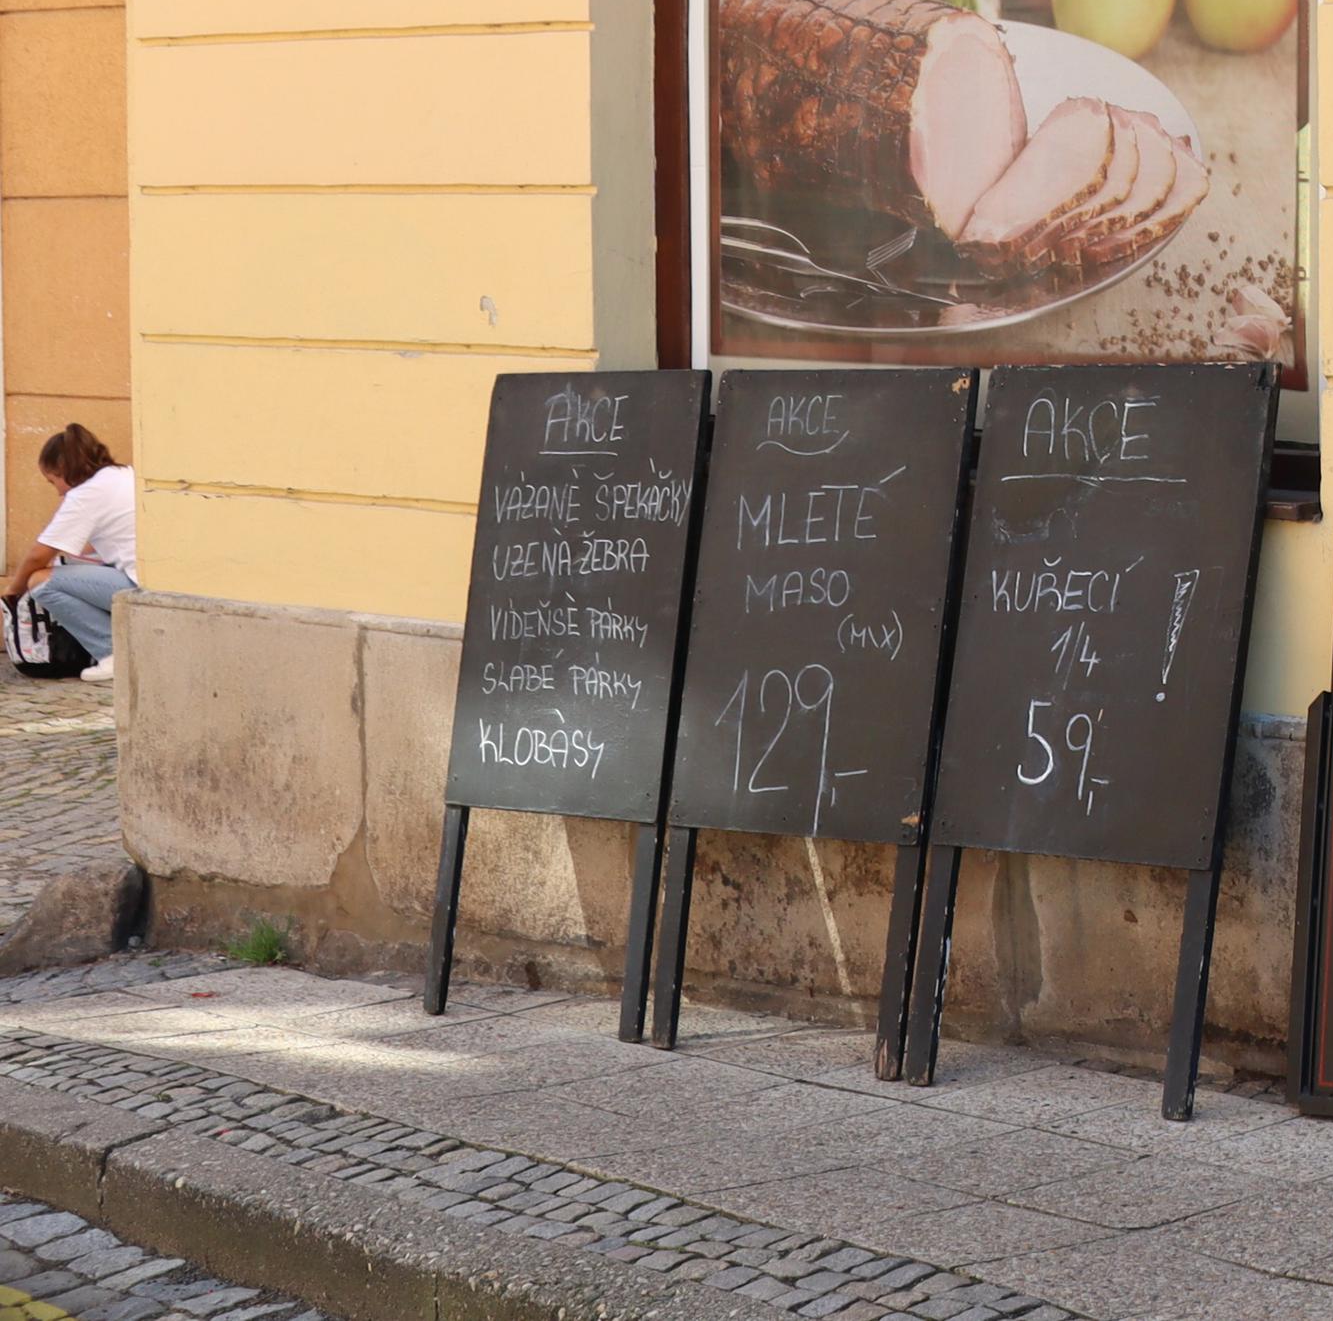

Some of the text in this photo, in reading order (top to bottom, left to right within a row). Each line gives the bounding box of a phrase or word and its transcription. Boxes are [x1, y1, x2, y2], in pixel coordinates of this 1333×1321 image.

[544, 384, 629, 444] AKCE
[766, 395, 843, 438] AKCE
[1022, 395, 1161, 465] AKCE
[736, 466, 907, 550] MLETÉ
[745, 568, 850, 613] MASO
[991, 556, 1144, 613] KUŘECÍ
[837, 611, 903, 661] (MIX)
[1051, 621, 1100, 690] 1/4
[482, 648, 565, 695] SLABÉ
